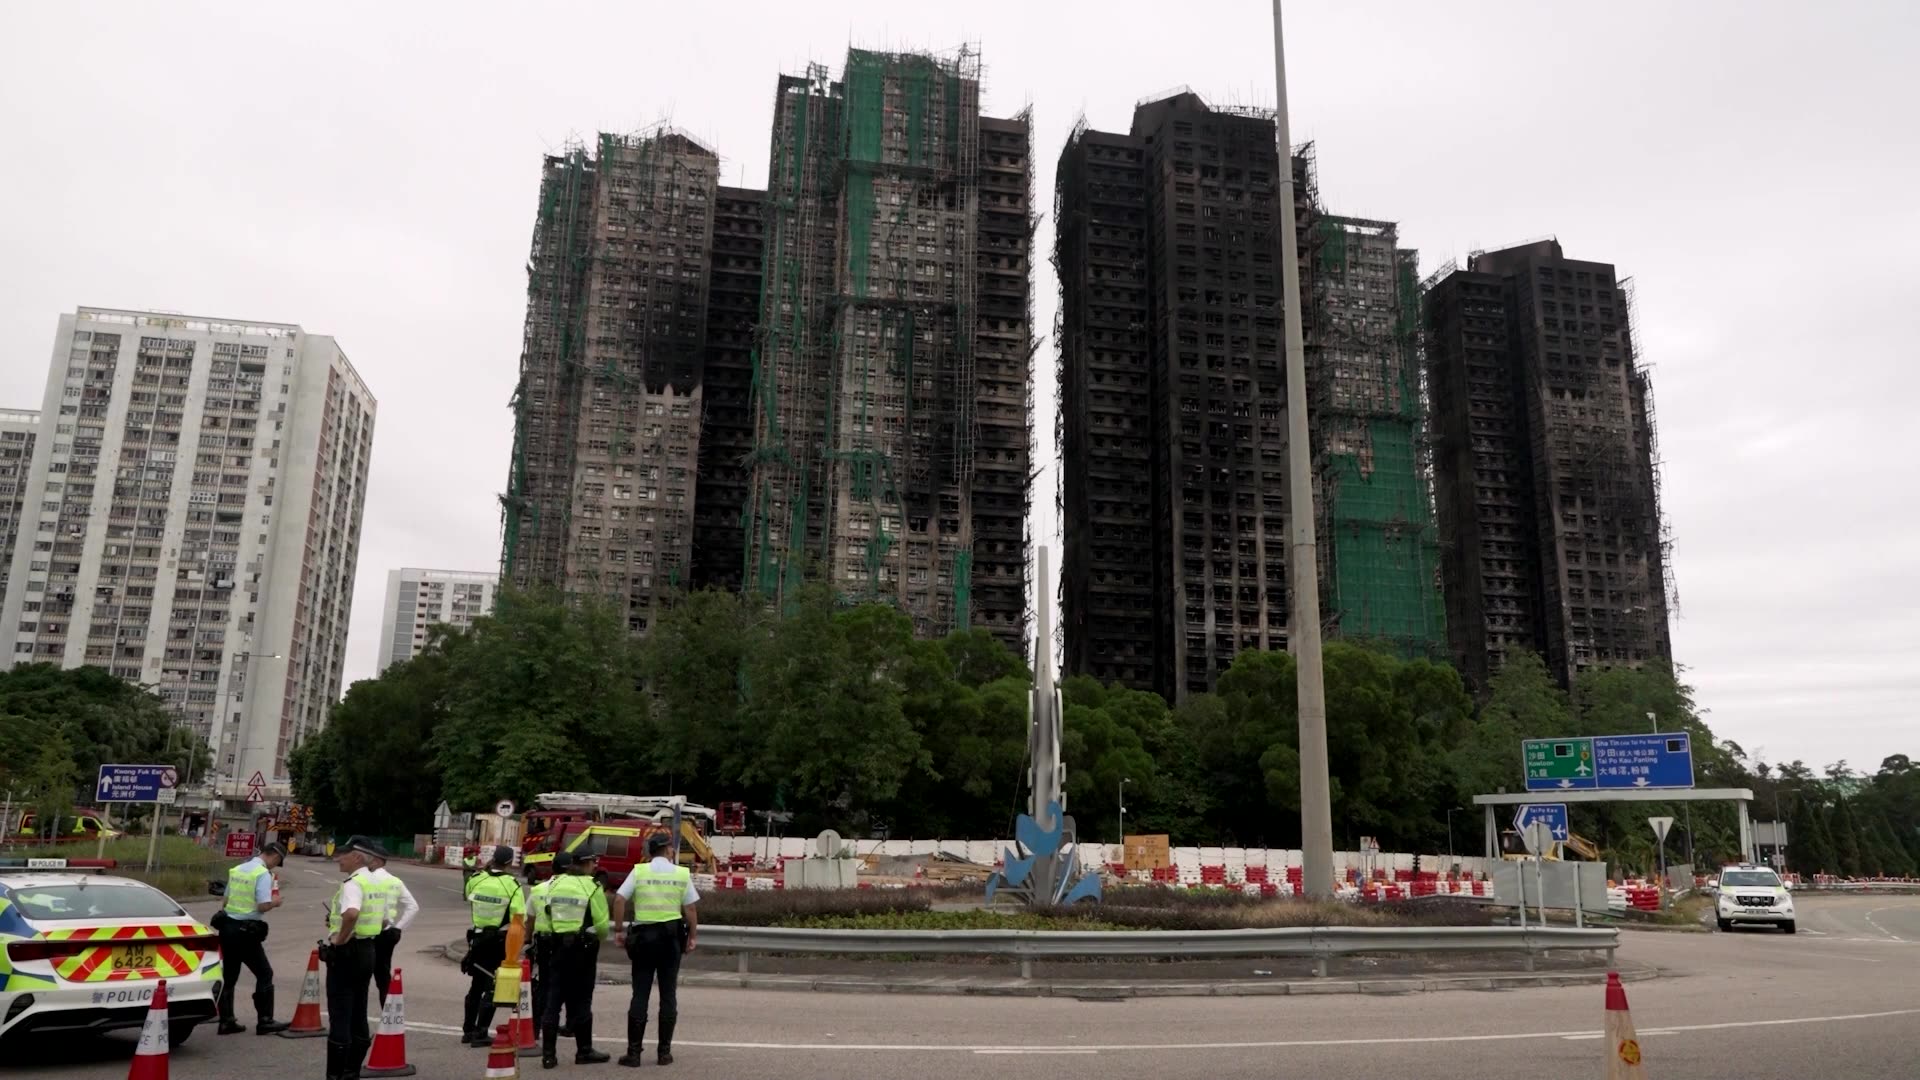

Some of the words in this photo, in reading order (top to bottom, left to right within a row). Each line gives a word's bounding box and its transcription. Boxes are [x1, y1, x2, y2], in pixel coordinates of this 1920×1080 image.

[1528, 751, 1546, 760] 沙田
[124, 947, 145, 956] AM
[113, 956, 153, 969] 6422
[106, 988, 158, 1003] POLIC
